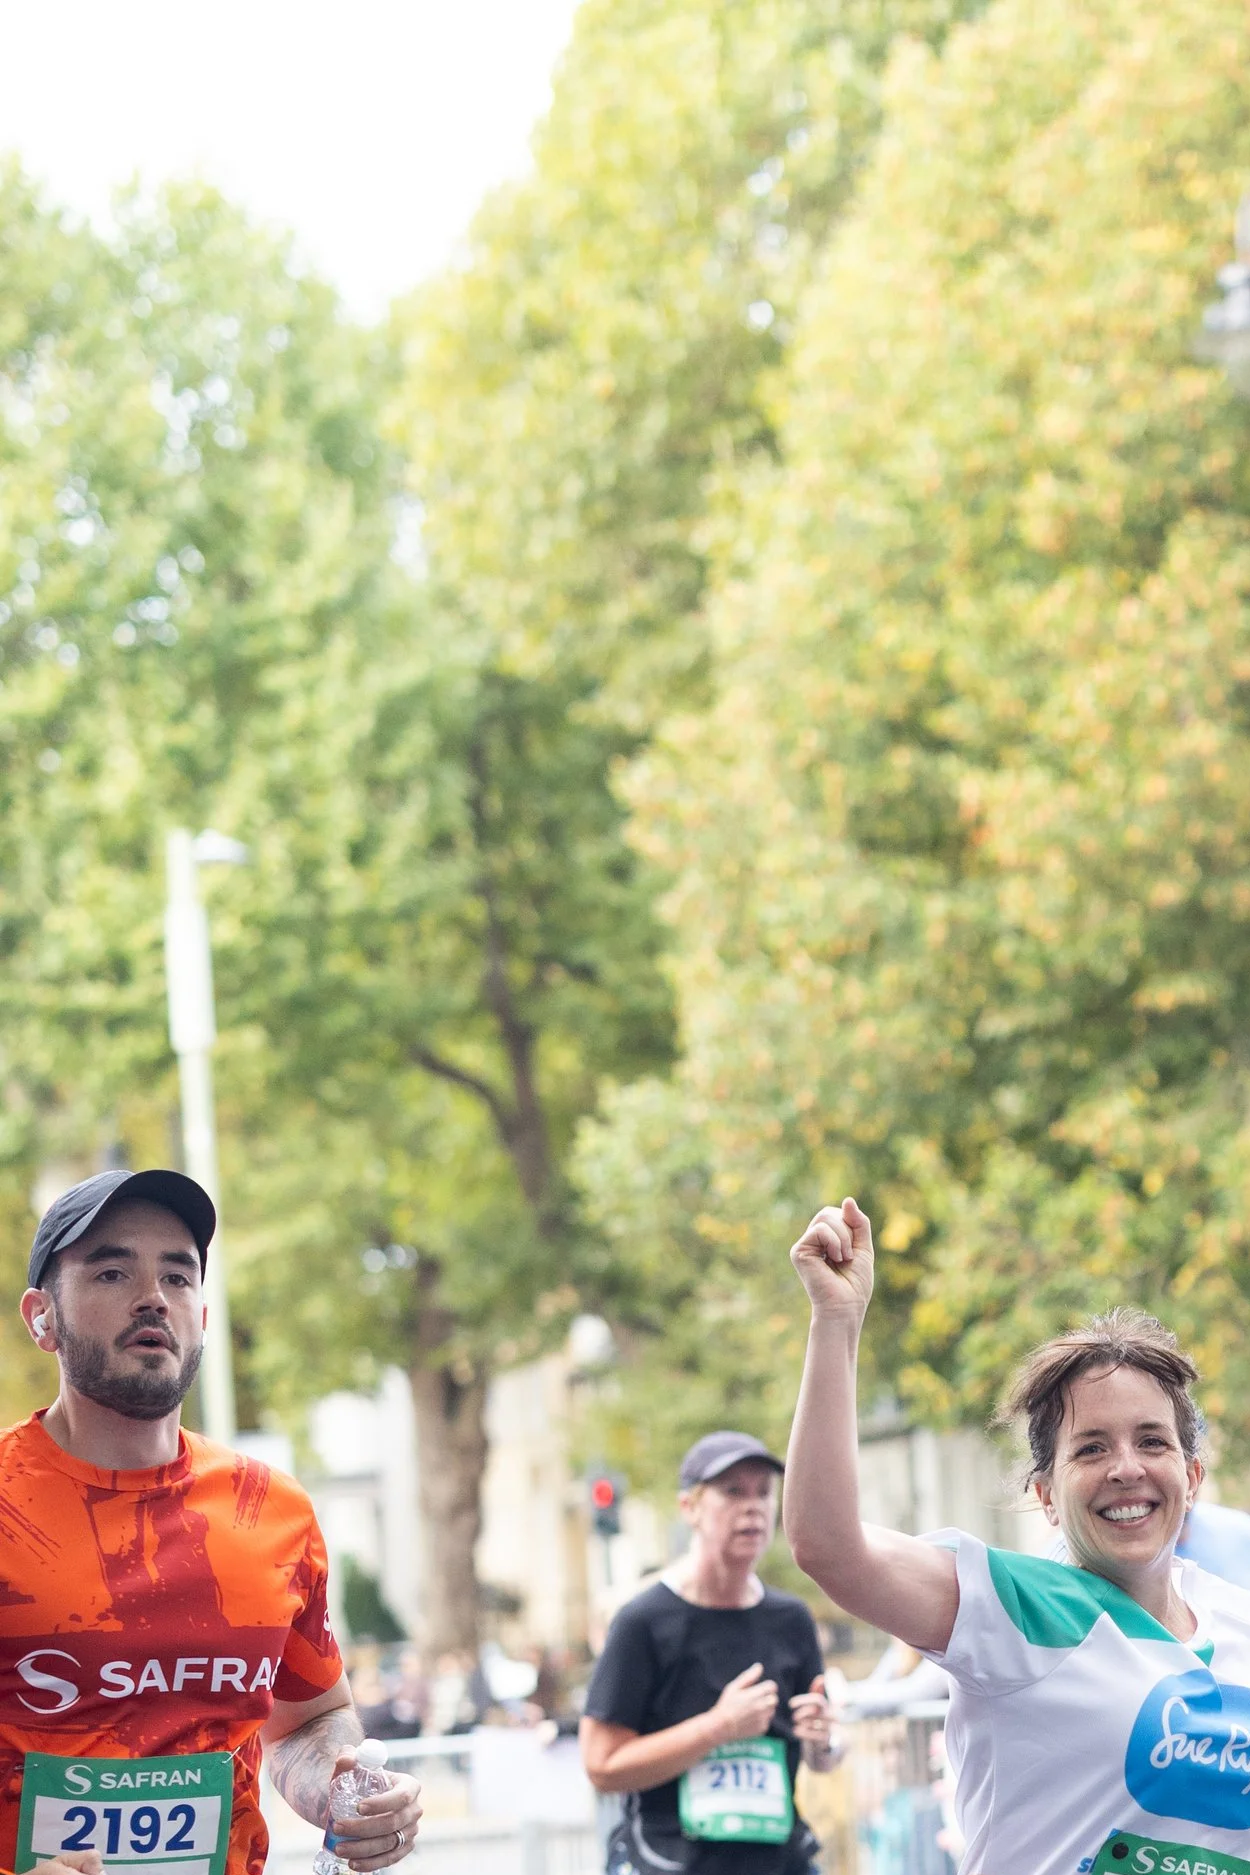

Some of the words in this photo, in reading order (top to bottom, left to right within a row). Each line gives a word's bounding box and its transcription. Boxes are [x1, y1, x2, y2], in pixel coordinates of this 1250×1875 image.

[1149, 1696, 1218, 1769] Sue
[100, 1768, 201, 1790] SAFRAN
[60, 1803, 196, 1854] 2192
